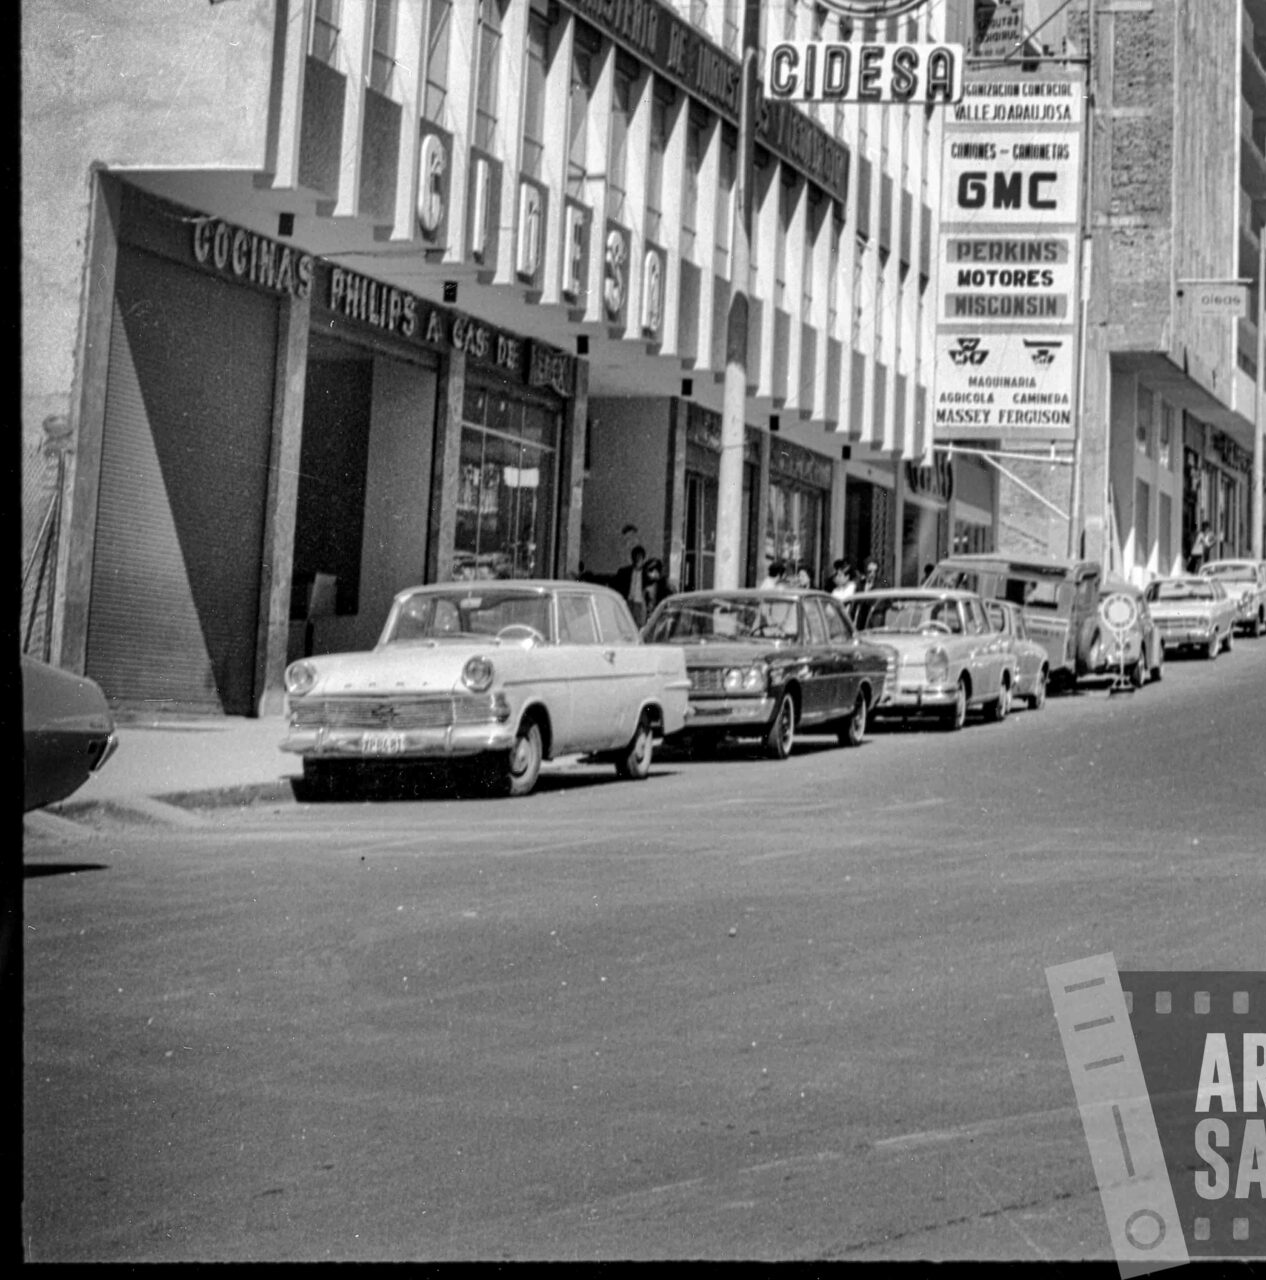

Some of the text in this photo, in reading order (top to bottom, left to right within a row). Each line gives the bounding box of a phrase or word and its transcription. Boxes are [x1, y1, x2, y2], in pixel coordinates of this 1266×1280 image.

[768, 43, 954, 101] CIDESA
[964, 83, 1072, 97] GANIZACION COMERCIAL
[951, 142, 1070, 160] CAMIONES CAMIONETAS
[957, 171, 1058, 210] GMC
[194, 221, 315, 299] COCINAS
[957, 241, 1058, 261] PERKINS
[958, 269, 1054, 287] MOTORES
[330, 268, 415, 336] PHILIPS
[425, 310, 442, 343] A
[955, 295, 1057, 316] WISCONSIN
[968, 376, 1037, 388] MAQUINARIA
[940, 392, 1069, 405] AGRICOLA CAMINERA
[936, 408, 1071, 425] MASSEY FERGUSON
